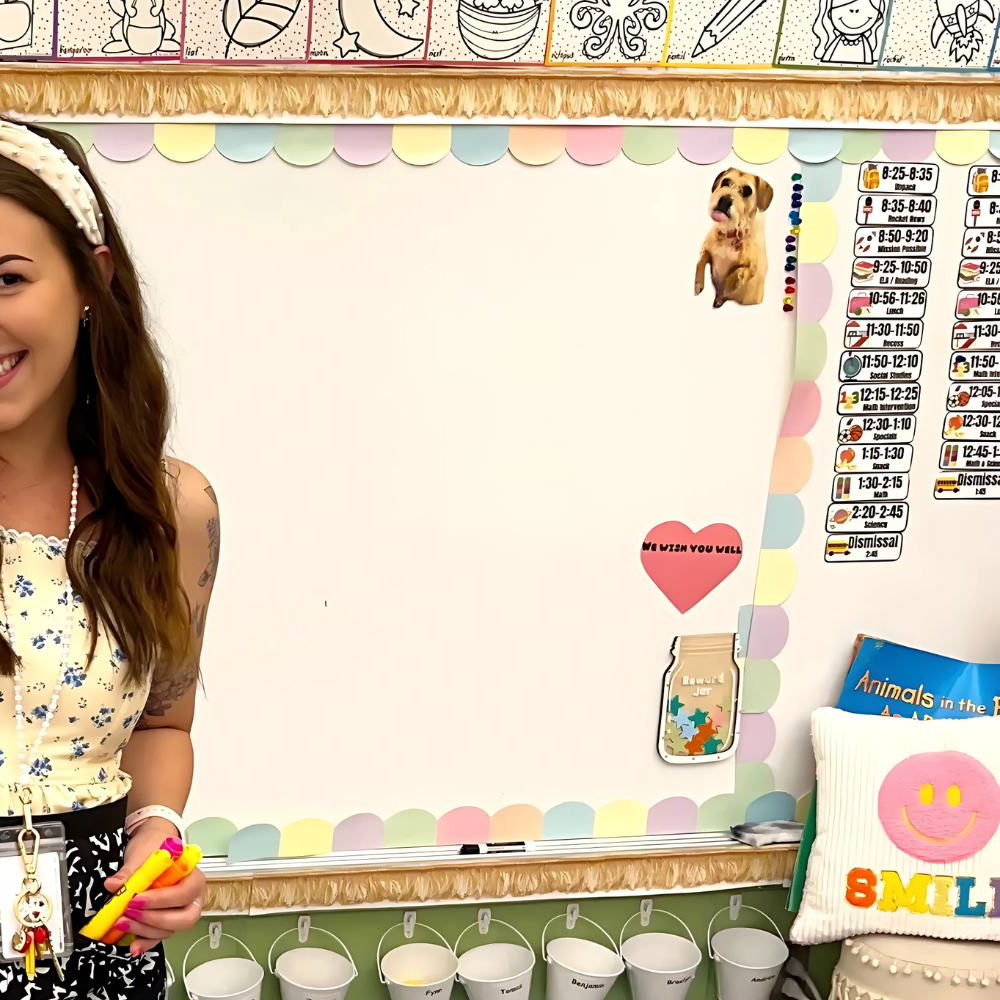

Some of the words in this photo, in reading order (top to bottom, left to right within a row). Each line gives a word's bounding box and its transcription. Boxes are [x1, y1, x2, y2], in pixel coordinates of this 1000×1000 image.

[881, 166, 933, 181] 8:25-8:35
[881, 198, 932, 213] 8:35-8:40
[878, 229, 928, 244] 8:50-9:20
[872, 260, 928, 274] 9:25-10:50
[879, 276, 890, 285] ELA
[869, 292, 925, 306] 10:56-11:26
[886, 307, 904, 315] Lunch
[866, 323, 920, 337] 11:30-11:50
[862, 355, 919, 369] 11:50-12:10
[870, 371, 888, 379] Social
[860, 387, 919, 402] 12:15-12:25
[862, 403, 878, 411] Math
[862, 417, 912, 431] 12:30-1:10
[873, 433, 898, 441] Specials
[979, 430, 997, 438] Snack
[862, 447, 904, 460] 1:15-1:30
[858, 475, 903, 490] 1:30-2:15
[957, 472, 1000, 487] Dismissa
[873, 490, 888, 498] Math
[851, 505, 904, 519] 2:20-2:45
[864, 521, 888, 529] Science
[660, 543, 687, 552] WISH
[690, 543, 714, 553] YOU
[716, 545, 742, 554] WELL
[848, 534, 899, 549] Dismissal
[682, 672, 724, 686] Reward
[692, 686, 712, 697] Jar
[854, 669, 934, 709] Animals
[940, 696, 954, 710] in
[958, 698, 986, 714] the
